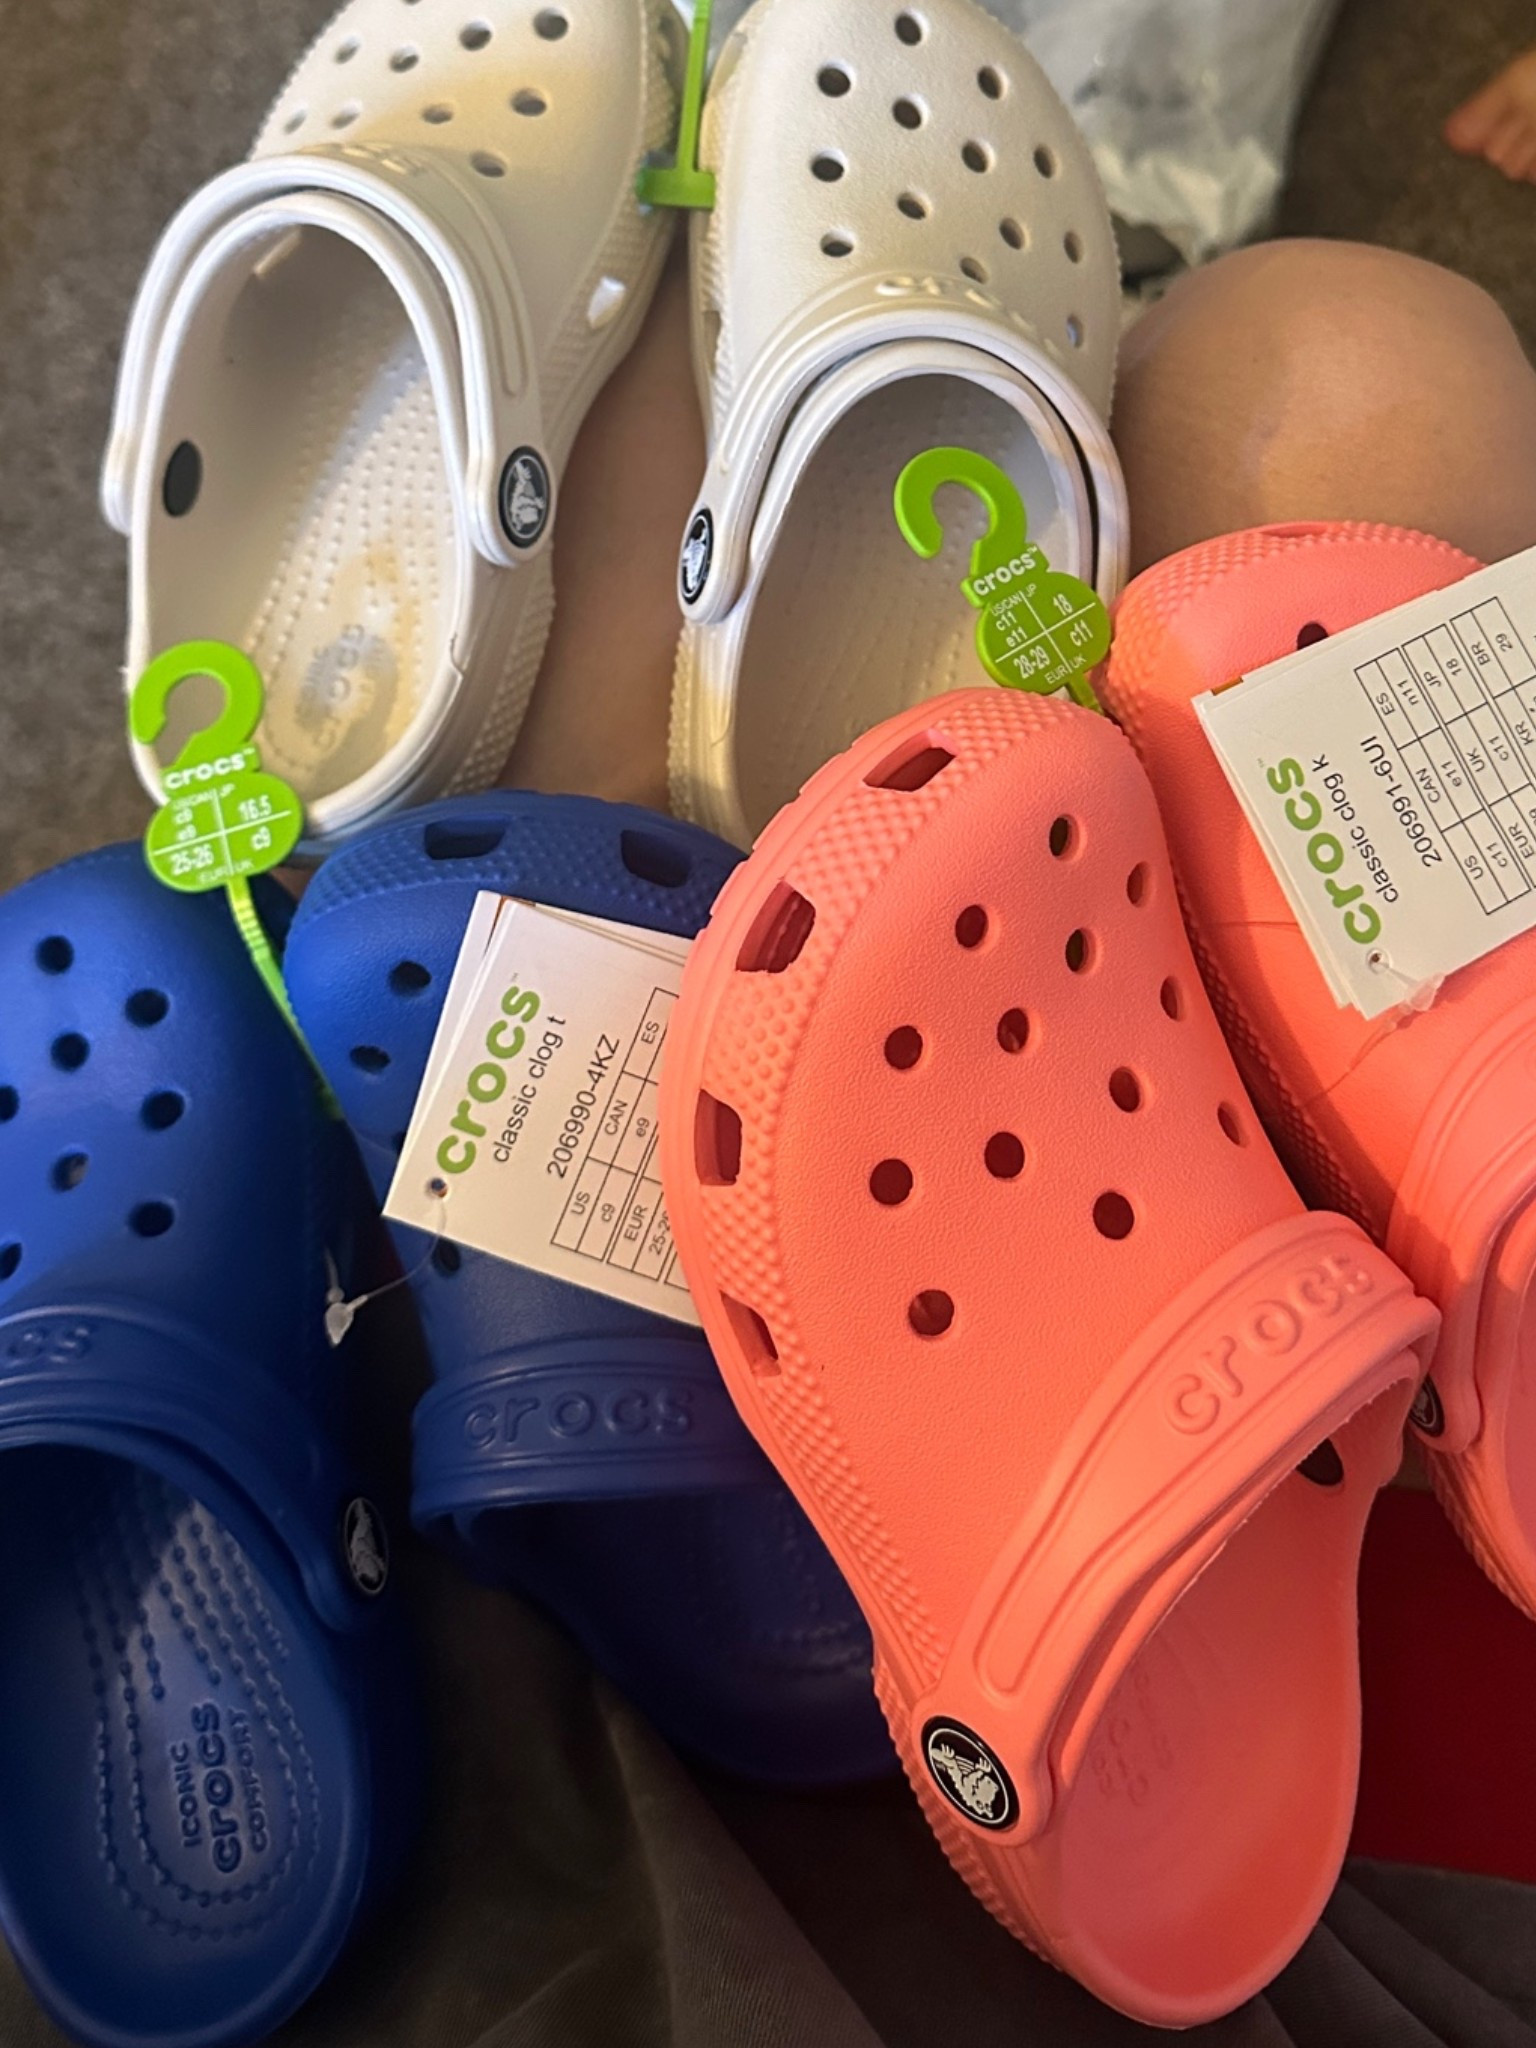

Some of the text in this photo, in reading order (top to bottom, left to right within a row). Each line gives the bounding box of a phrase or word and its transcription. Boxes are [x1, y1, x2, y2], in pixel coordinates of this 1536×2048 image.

[1025, 583, 1037, 598] JP
[1053, 593, 1073, 616] 18
[995, 611, 1017, 631] c11
[1069, 619, 1094, 646] c11
[1005, 627, 1028, 647] e11
[1495, 633, 1514, 653] 29
[1013, 645, 1050, 679] 28-29
[1070, 654, 1088, 669] UK
[1471, 641, 1491, 666] BR
[1044, 665, 1069, 684] EUR
[1423, 671, 1442, 688] JP
[1446, 658, 1462, 676] 18
[1375, 692, 1396, 717] ES
[1397, 679, 1420, 706] n11
[1514, 720, 1534, 745] KR
[1466, 748, 1486, 773] UK
[1489, 736, 1510, 762] c11
[1416, 768, 1441, 803] CAN
[1441, 760, 1462, 787] e11
[1360, 735, 1443, 867] 206991-6UI
[1311, 754, 1399, 903] classic clog k
[1508, 822, 1535, 859] EUR
[1463, 855, 1484, 880] US
[1486, 842, 1508, 868] c11
[641, 1021, 660, 1045] ES
[493, 1015, 566, 1162] classic clog t
[547, 1034, 620, 1179] 206990-4KZ
[604, 1099, 628, 1136] CAN
[635, 1117, 650, 1137] e9
[571, 1191, 591, 1216] US
[601, 1203, 616, 1223] c9
[623, 1205, 649, 1242] EUR
[650, 1211, 671, 1255] 25-2
[1163, 1254, 1375, 1436] crocs
[464, 1387, 692, 1450] crocs
[170, 1740, 203, 1848] ICONIC
[190, 1702, 242, 1874] crocs
